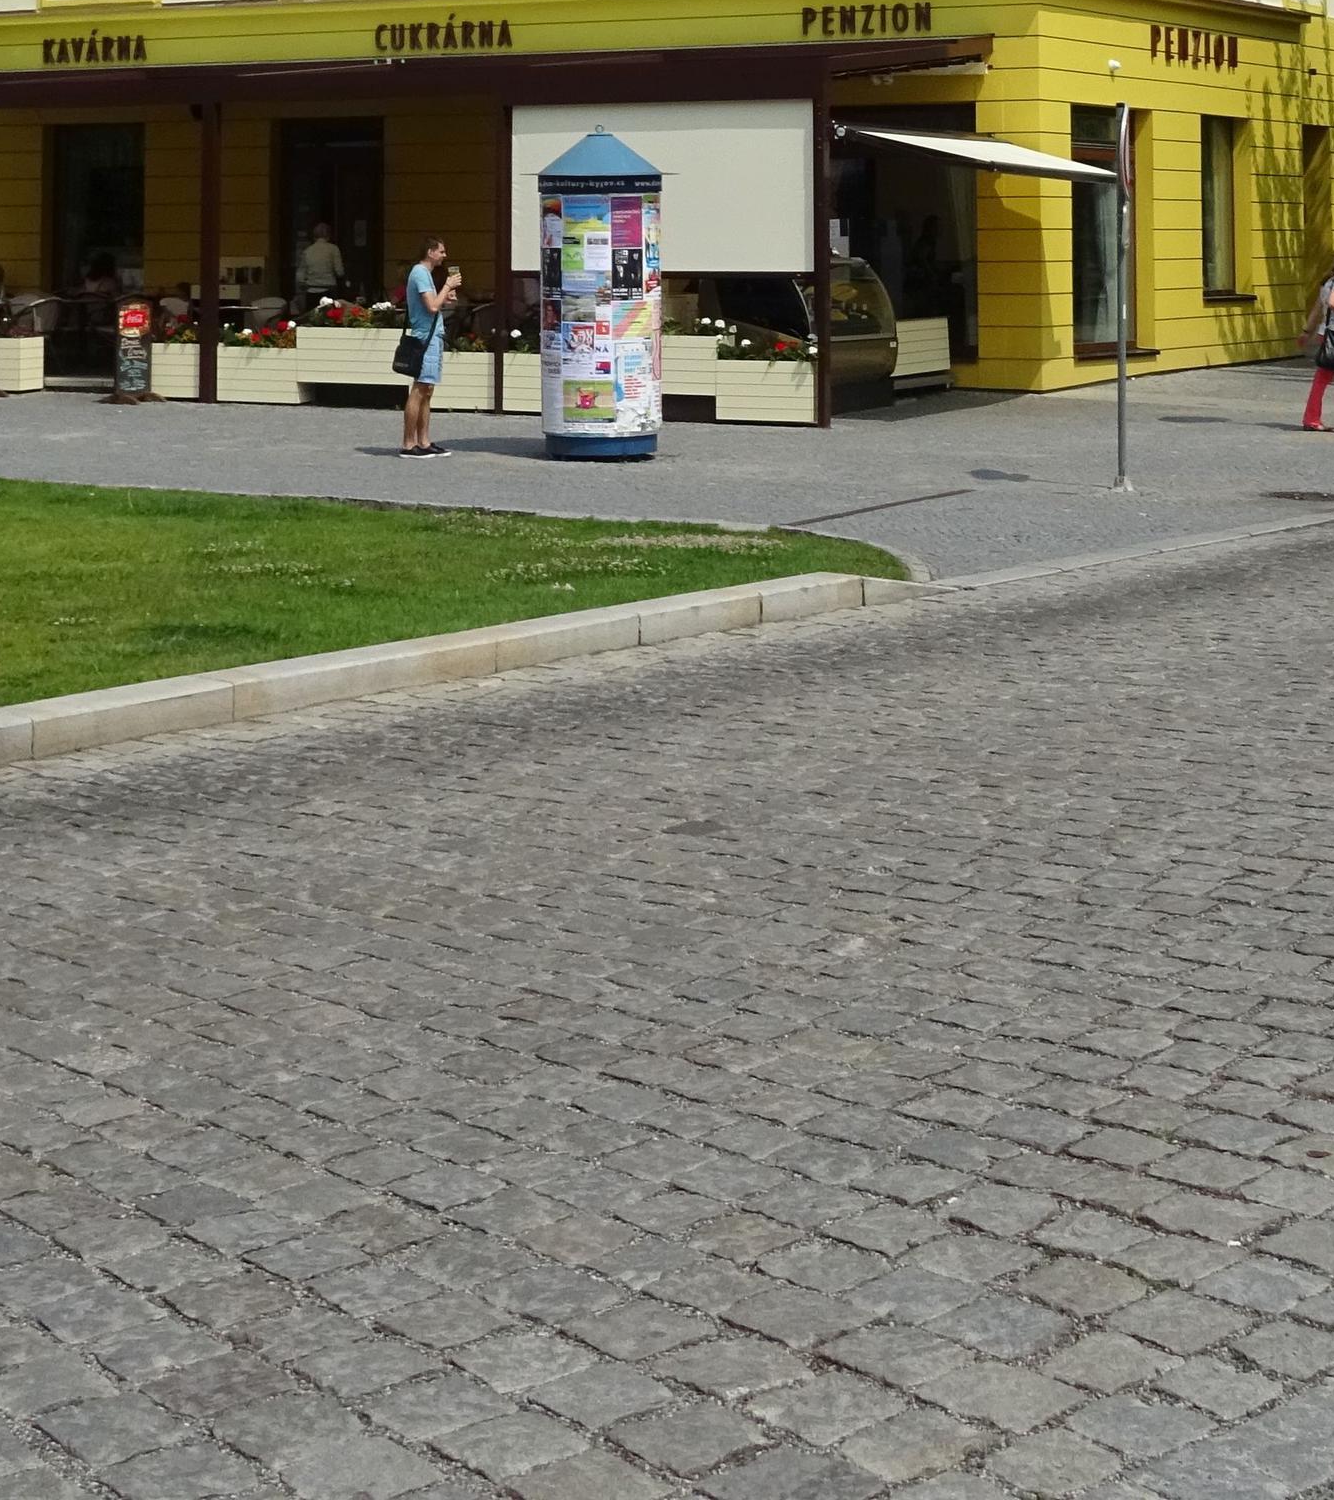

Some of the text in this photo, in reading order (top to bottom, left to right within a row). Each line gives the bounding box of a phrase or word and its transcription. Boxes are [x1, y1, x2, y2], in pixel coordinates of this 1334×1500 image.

[375, 13, 513, 51] CUKRÁRNA
[802, 2, 931, 36] PENZION
[43, 29, 147, 63] KAVÁRNA
[1150, 24, 1238, 71] PENZION
